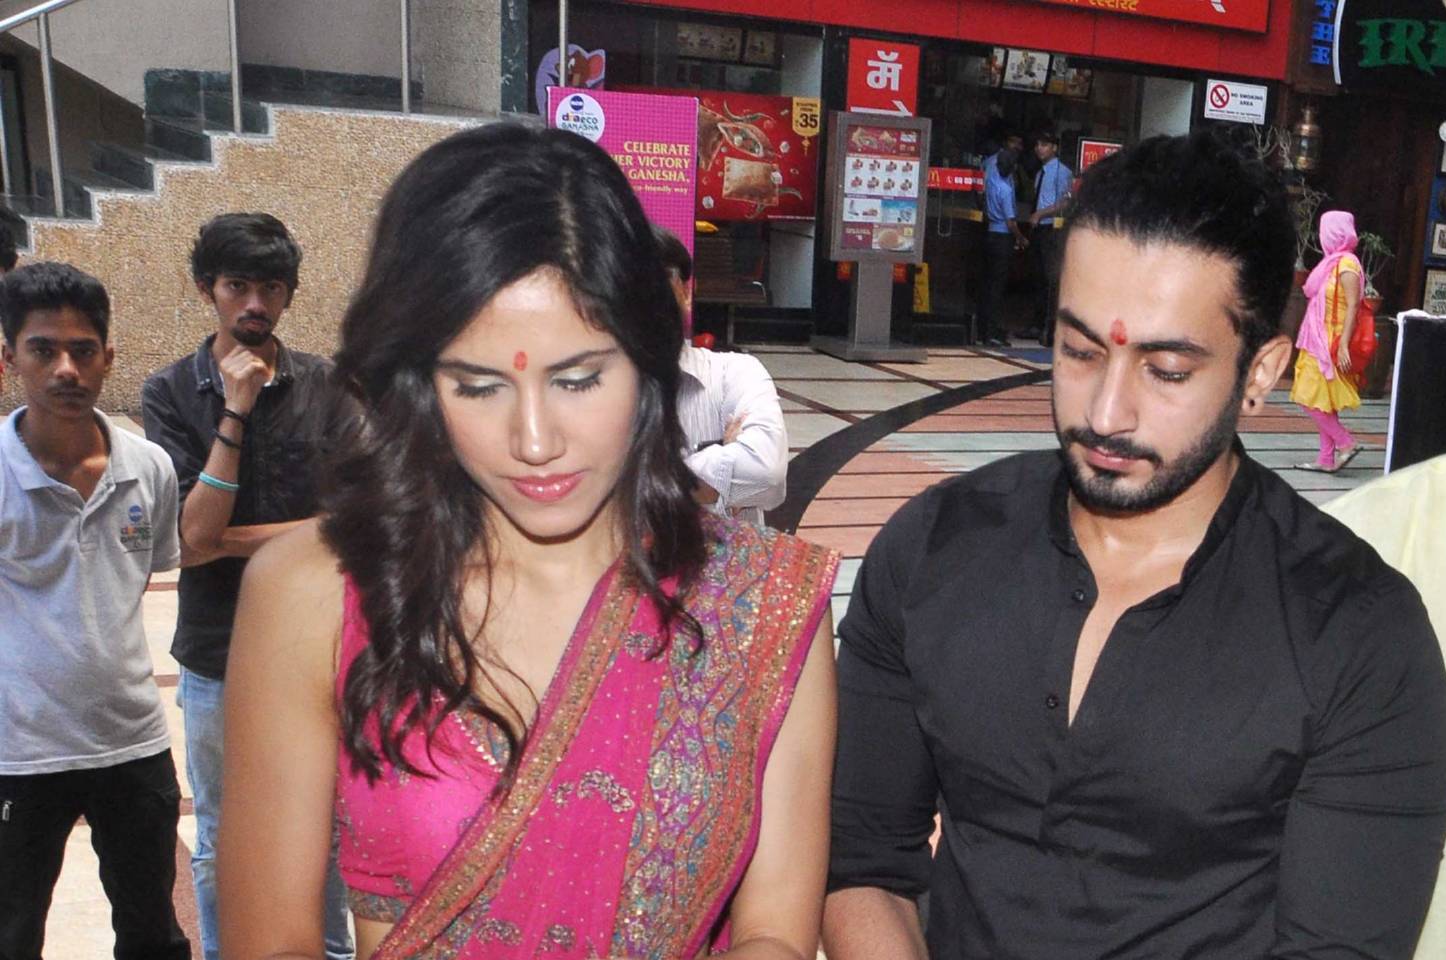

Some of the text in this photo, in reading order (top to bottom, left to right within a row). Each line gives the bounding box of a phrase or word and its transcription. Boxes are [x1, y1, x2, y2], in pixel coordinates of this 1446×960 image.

[800, 113, 818, 128] 35
[624, 141, 690, 155] CELEBRATE
[609, 154, 690, 169] HER VICTORY
[628, 169, 690, 182] GANESHA.
